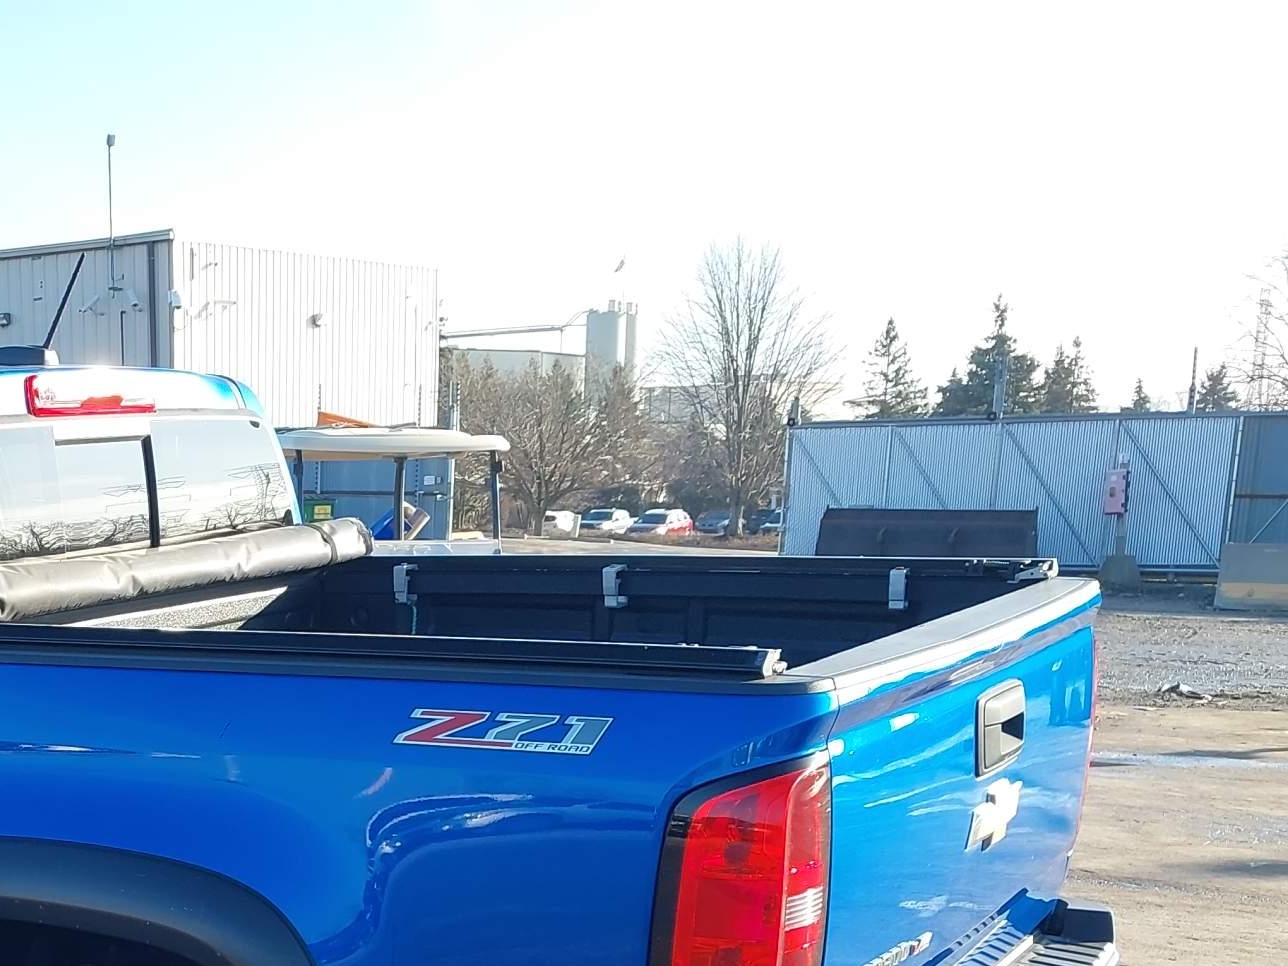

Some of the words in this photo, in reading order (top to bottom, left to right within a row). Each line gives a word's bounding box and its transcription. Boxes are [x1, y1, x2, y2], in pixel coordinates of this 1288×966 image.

[393, 708, 614, 751] Z71
[514, 742, 545, 751] OFF
[547, 743, 591, 754] ROAD
